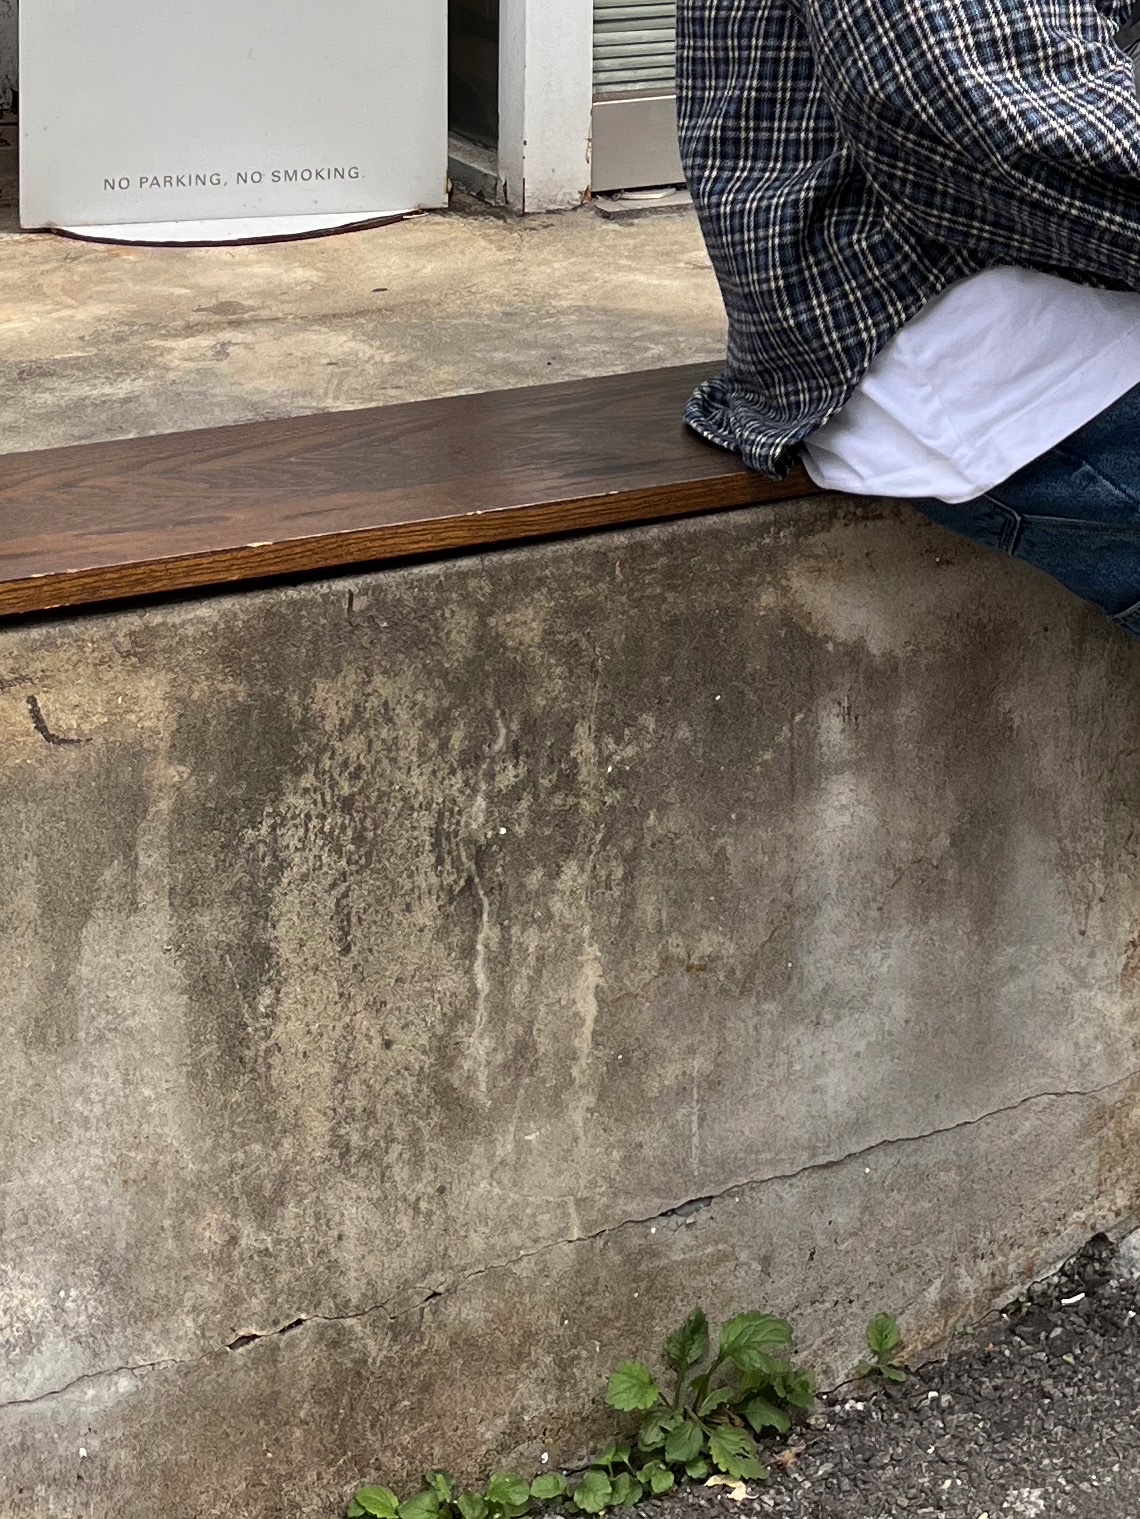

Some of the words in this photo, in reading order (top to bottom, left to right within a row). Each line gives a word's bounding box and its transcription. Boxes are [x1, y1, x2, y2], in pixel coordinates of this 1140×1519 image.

[103, 177, 130, 191] NO
[139, 173, 228, 189] PARKING,
[236, 171, 263, 185] NO
[271, 166, 366, 183] SMOKING.
